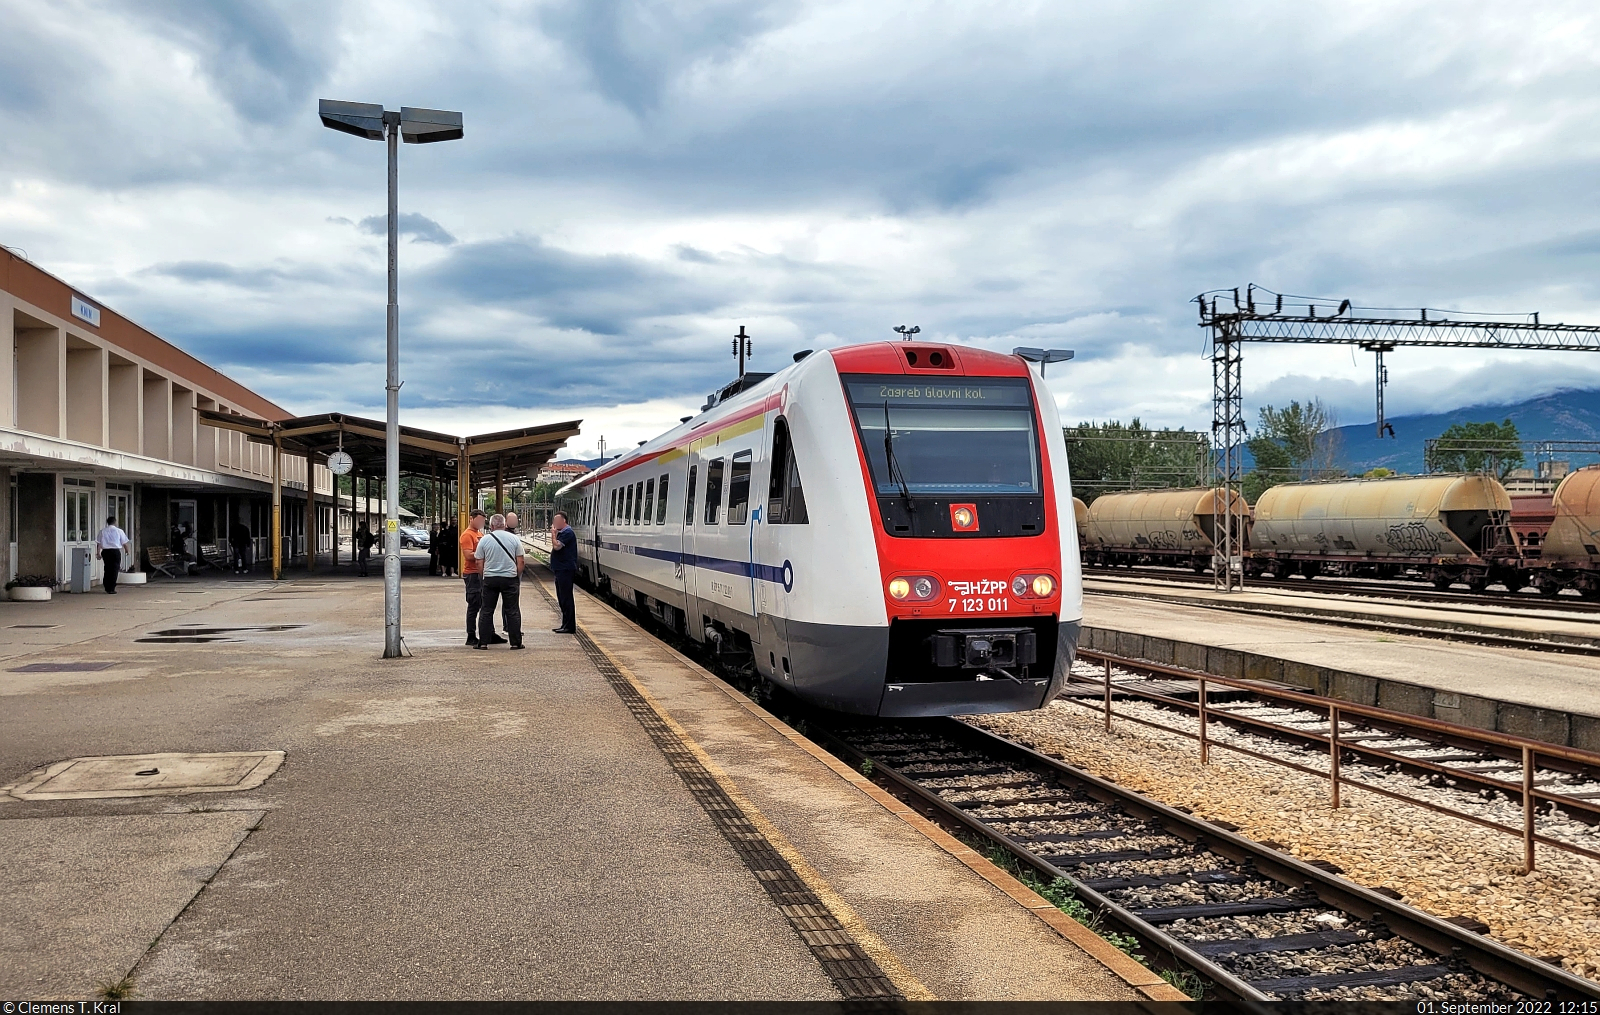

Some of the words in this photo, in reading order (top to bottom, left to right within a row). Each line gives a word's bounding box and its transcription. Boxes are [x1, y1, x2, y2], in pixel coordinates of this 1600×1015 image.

[880, 386, 920, 398] Zagreb
[925, 386, 961, 399] Glavni
[965, 387, 986, 399] kol.
[948, 598, 957, 612] 7
[961, 598, 984, 612] 123
[987, 597, 1008, 612] 011
